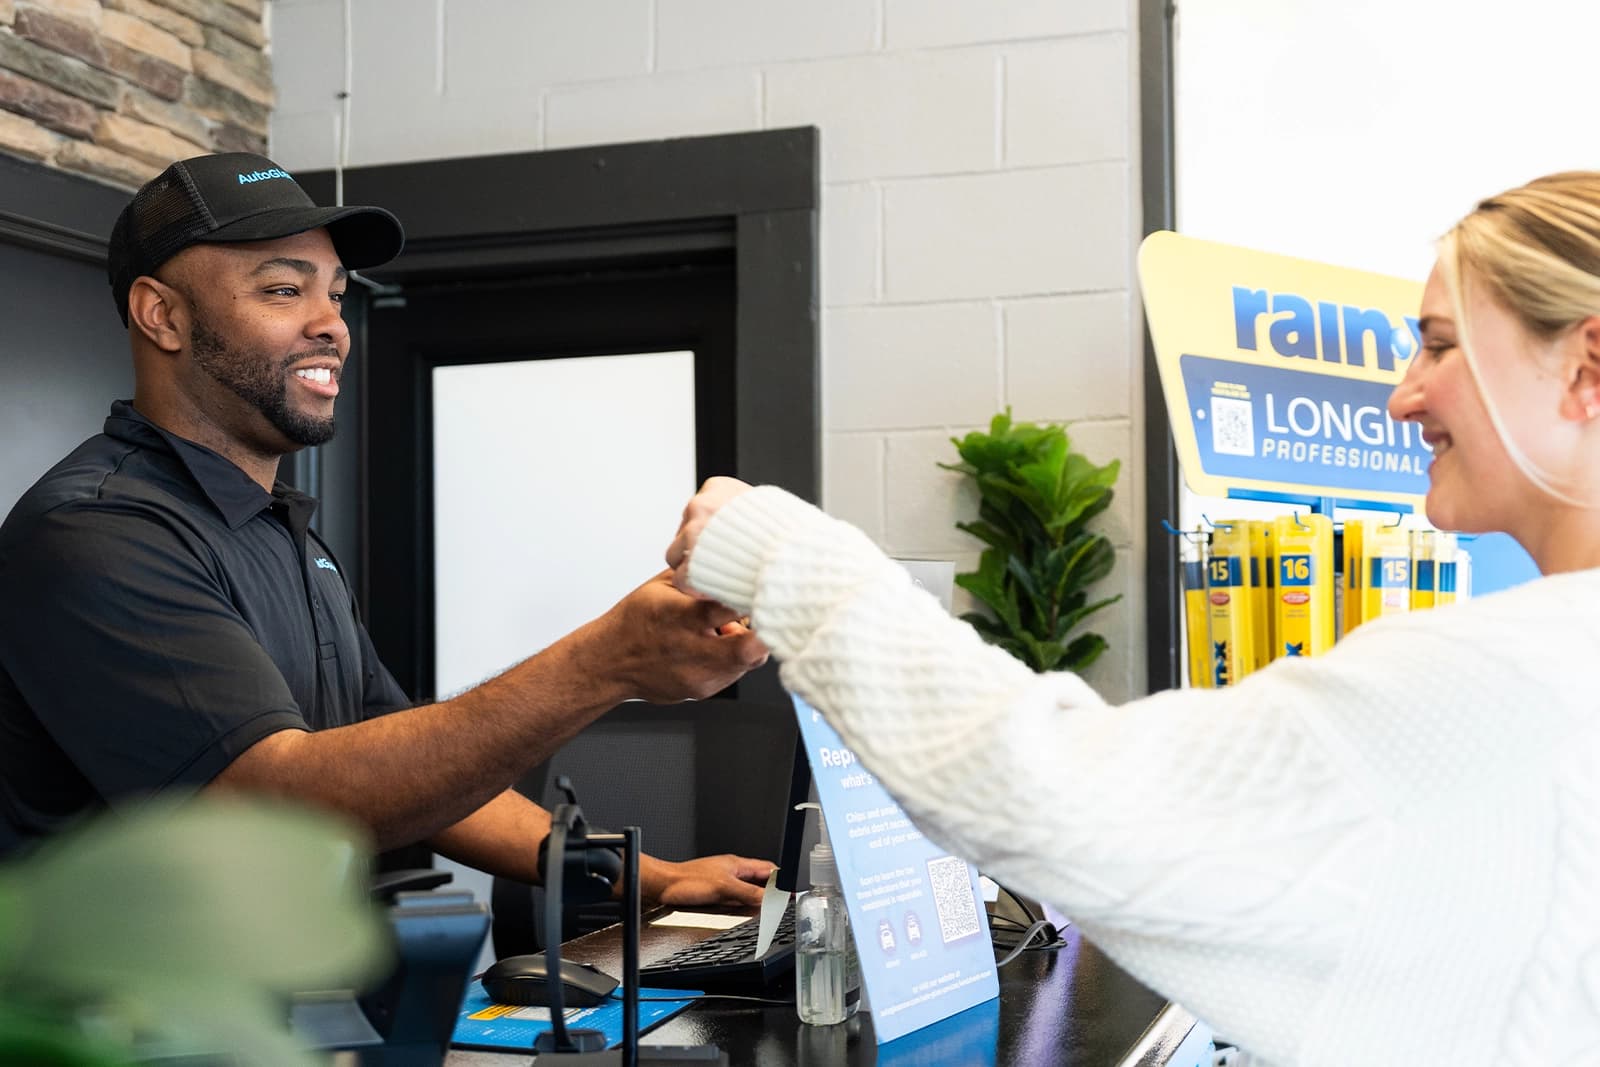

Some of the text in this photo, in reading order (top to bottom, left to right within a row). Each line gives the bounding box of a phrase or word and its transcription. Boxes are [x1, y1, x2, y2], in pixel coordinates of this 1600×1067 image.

[1262, 438, 1425, 476] PROFESSIONAL
[1209, 560, 1229, 581] 15
[1283, 559, 1309, 580] 16
[1384, 560, 1408, 582] 15
[841, 771, 873, 790] what's
